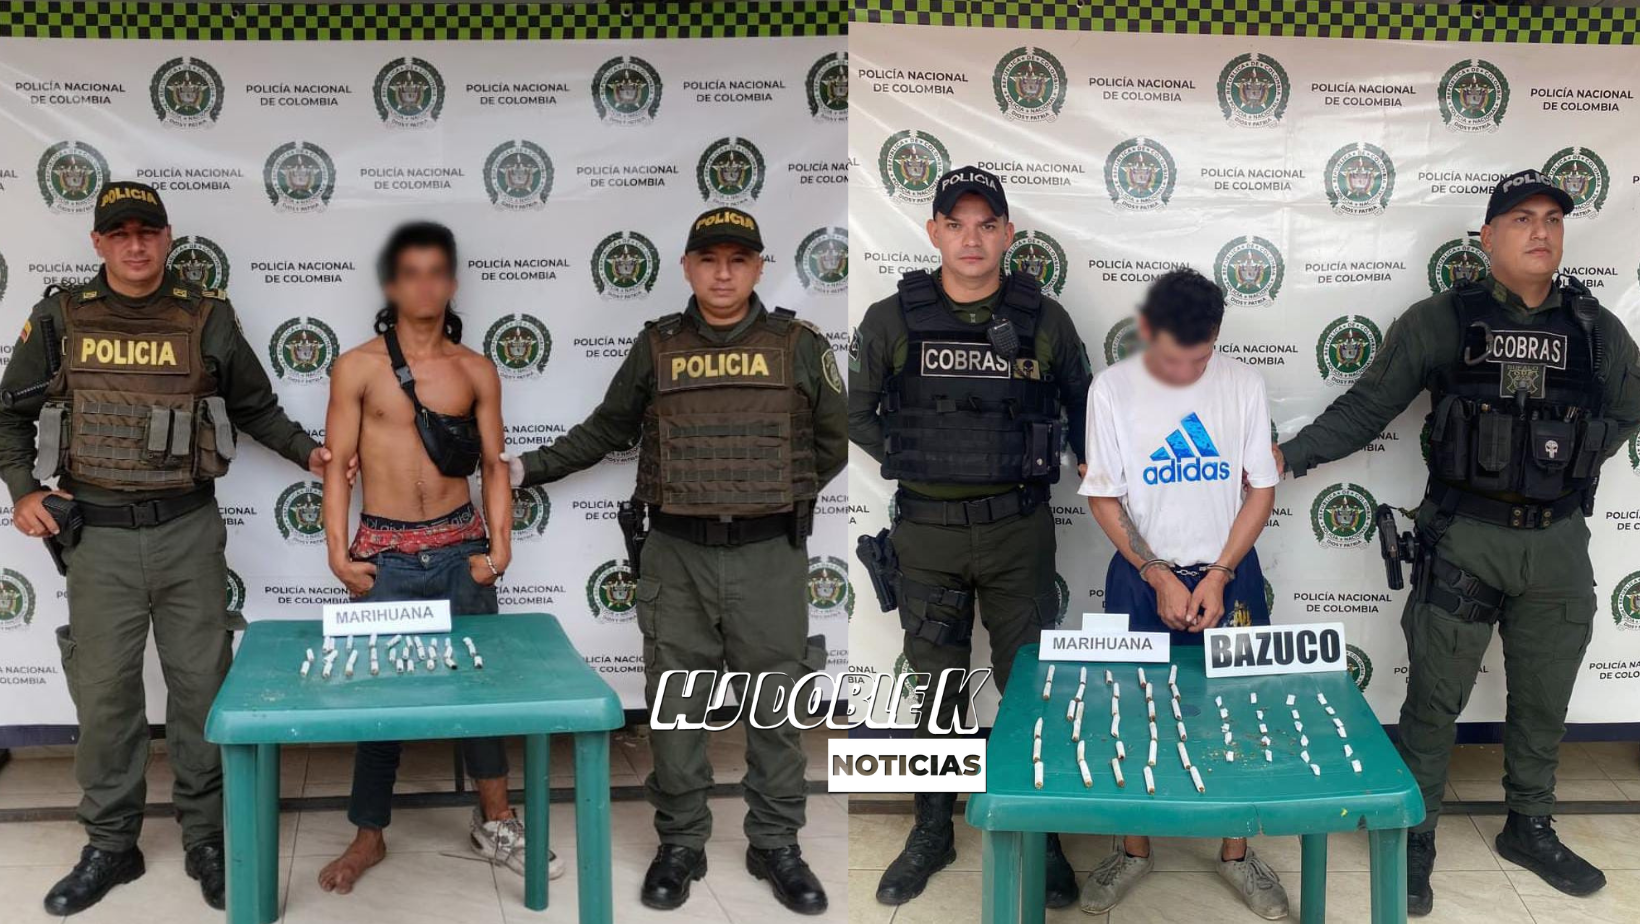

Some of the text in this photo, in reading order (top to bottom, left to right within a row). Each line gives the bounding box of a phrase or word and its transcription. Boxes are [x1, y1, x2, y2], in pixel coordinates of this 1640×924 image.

[858, 69, 968, 83] POLICÍA NACIONAL
[16, 81, 125, 93] POLICÍA NACIONAL
[246, 83, 352, 94] POLICÍA NACIONAL
[466, 82, 570, 93] POLICÍA NACIONAL
[683, 80, 785, 90] POLICÍA NACIONAL
[1089, 77, 1195, 89] POLICÍA NACIONAL
[1311, 82, 1416, 95] POLICÍA NACIONAL
[873, 83, 954, 95] DE COLOMBIA
[1530, 87, 1634, 100] POLICÍA NACIONAL
[31, 95, 111, 105] DE COLOMBIA
[260, 97, 338, 107] DE COLOMBIA
[480, 95, 556, 105] DE COLOMBIA
[697, 92, 772, 103] DE COLOMBIA
[1103, 91, 1182, 102] DE COLOMBIA
[1324, 96, 1402, 107] DE COLOMBIA
[1543, 101, 1619, 112] DE COLOMBIA
[577, 164, 678, 176] POLICÍA NACIONAL
[788, 161, 830, 172] POLICÍA
[978, 159, 1085, 173] POLICÍA NACIONAL
[137, 166, 244, 178] POLICÍA NACIONAL
[360, 167, 464, 178] POLICÍA NACIONAL
[1201, 167, 1305, 179] POLICÍA NACIONAL
[1419, 171, 1462, 182] POLICÍA
[374, 180, 451, 190] DE COLOMBIA
[590, 177, 665, 187] DE COLOMBIA
[800, 175, 815, 184] DE
[942, 172, 998, 192] POLICIA
[1010, 175, 1071, 186] COLOMBIA
[1502, 172, 1552, 193] POLIC
[168, 181, 230, 191] COLOMBIA
[1214, 181, 1291, 191] DE COLOMBIA
[1431, 184, 1498, 194] DE COLOMB
[101, 187, 157, 207] POLICIA
[696, 211, 755, 230] POLICIA
[864, 250, 941, 265] POLICÍA NACI
[28, 262, 73, 273] POLICÍA
[251, 261, 355, 271] POLICÍA NACIONAL
[468, 258, 570, 269] POLICÍA NACIONAL
[1089, 260, 1133, 271] POLICÍA
[1305, 261, 1406, 273] POLICÍA NACIONAL
[879, 264, 894, 275] DE
[265, 273, 342, 283] DE COLOMBIA
[481, 270, 556, 281] DE COLOMBIA
[1103, 272, 1118, 282] DE
[1318, 273, 1391, 284] DE COLOMBIA
[574, 336, 616, 347] POLICÍA
[81, 338, 177, 366] POLICIA
[586, 349, 601, 358] DE
[1241, 345, 1298, 354] NACIONAL
[1493, 335, 1561, 362] COBRAS
[925, 348, 1008, 372] COBRAS
[672, 353, 769, 381] POLICIA
[513, 424, 566, 433] NACIONAL
[1143, 457, 1230, 486] adidas
[573, 500, 614, 510] POLICÍA
[1052, 506, 1086, 515] IONAL
[217, 507, 257, 516] CIONAL
[586, 512, 600, 521] DE
[1606, 511, 1638, 521] POLICÍ
[1617, 522, 1630, 531] DE
[265, 586, 350, 596] POLICÍA NACION
[514, 585, 566, 594] NACIONAL
[1294, 592, 1391, 602] POLICÍA NACIONAL
[1306, 604, 1378, 613] DE COLOMBIA
[335, 606, 434, 624] MARIHUANA
[1053, 637, 1153, 650] MARIHUANA
[1210, 629, 1342, 669] BAZUCO
[848, 666, 876, 674] ONAL
[1589, 662, 1627, 672] POLICÍA
[1615, 670, 1640, 679] COLO
